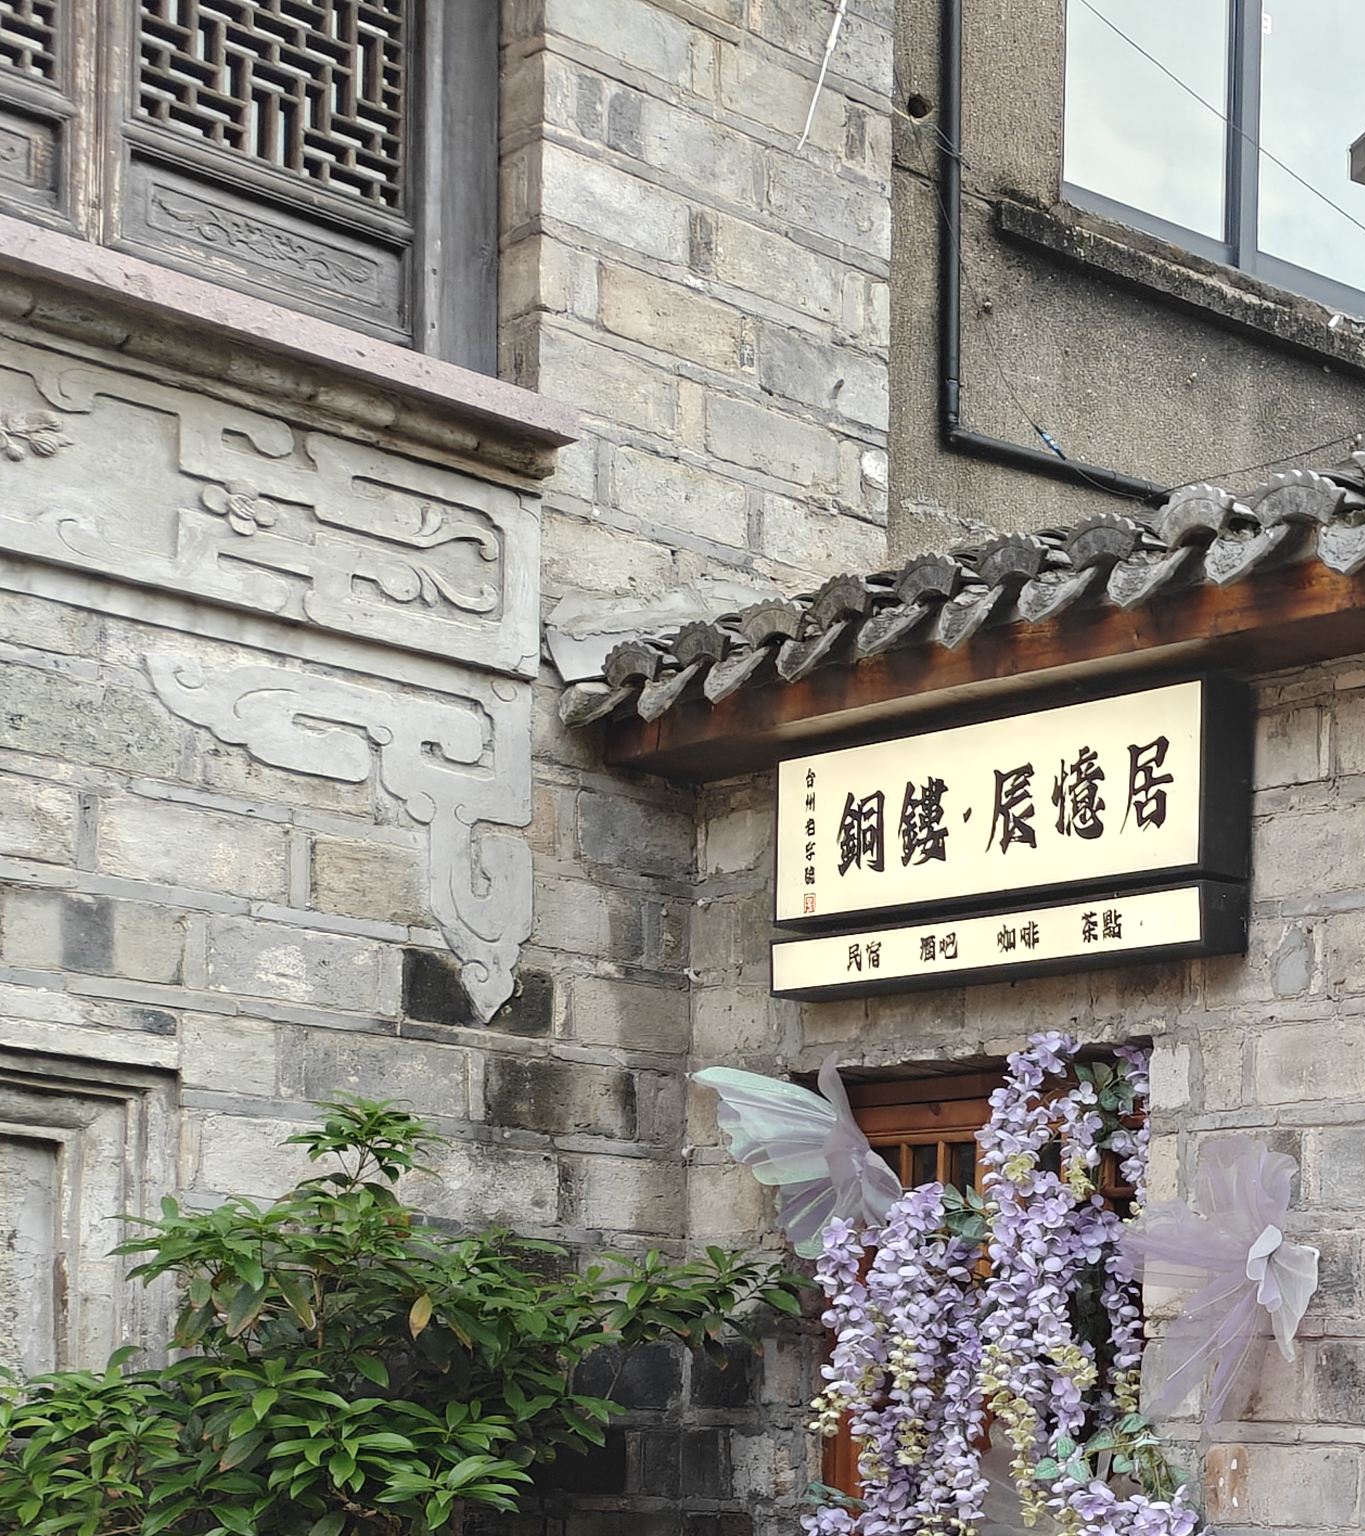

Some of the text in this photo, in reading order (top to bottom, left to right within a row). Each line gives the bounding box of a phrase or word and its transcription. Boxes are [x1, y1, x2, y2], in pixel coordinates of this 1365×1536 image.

[846, 940, 883, 972] 民宿
[919, 932, 960, 963] 酒吧
[996, 920, 1041, 954] 咖啡
